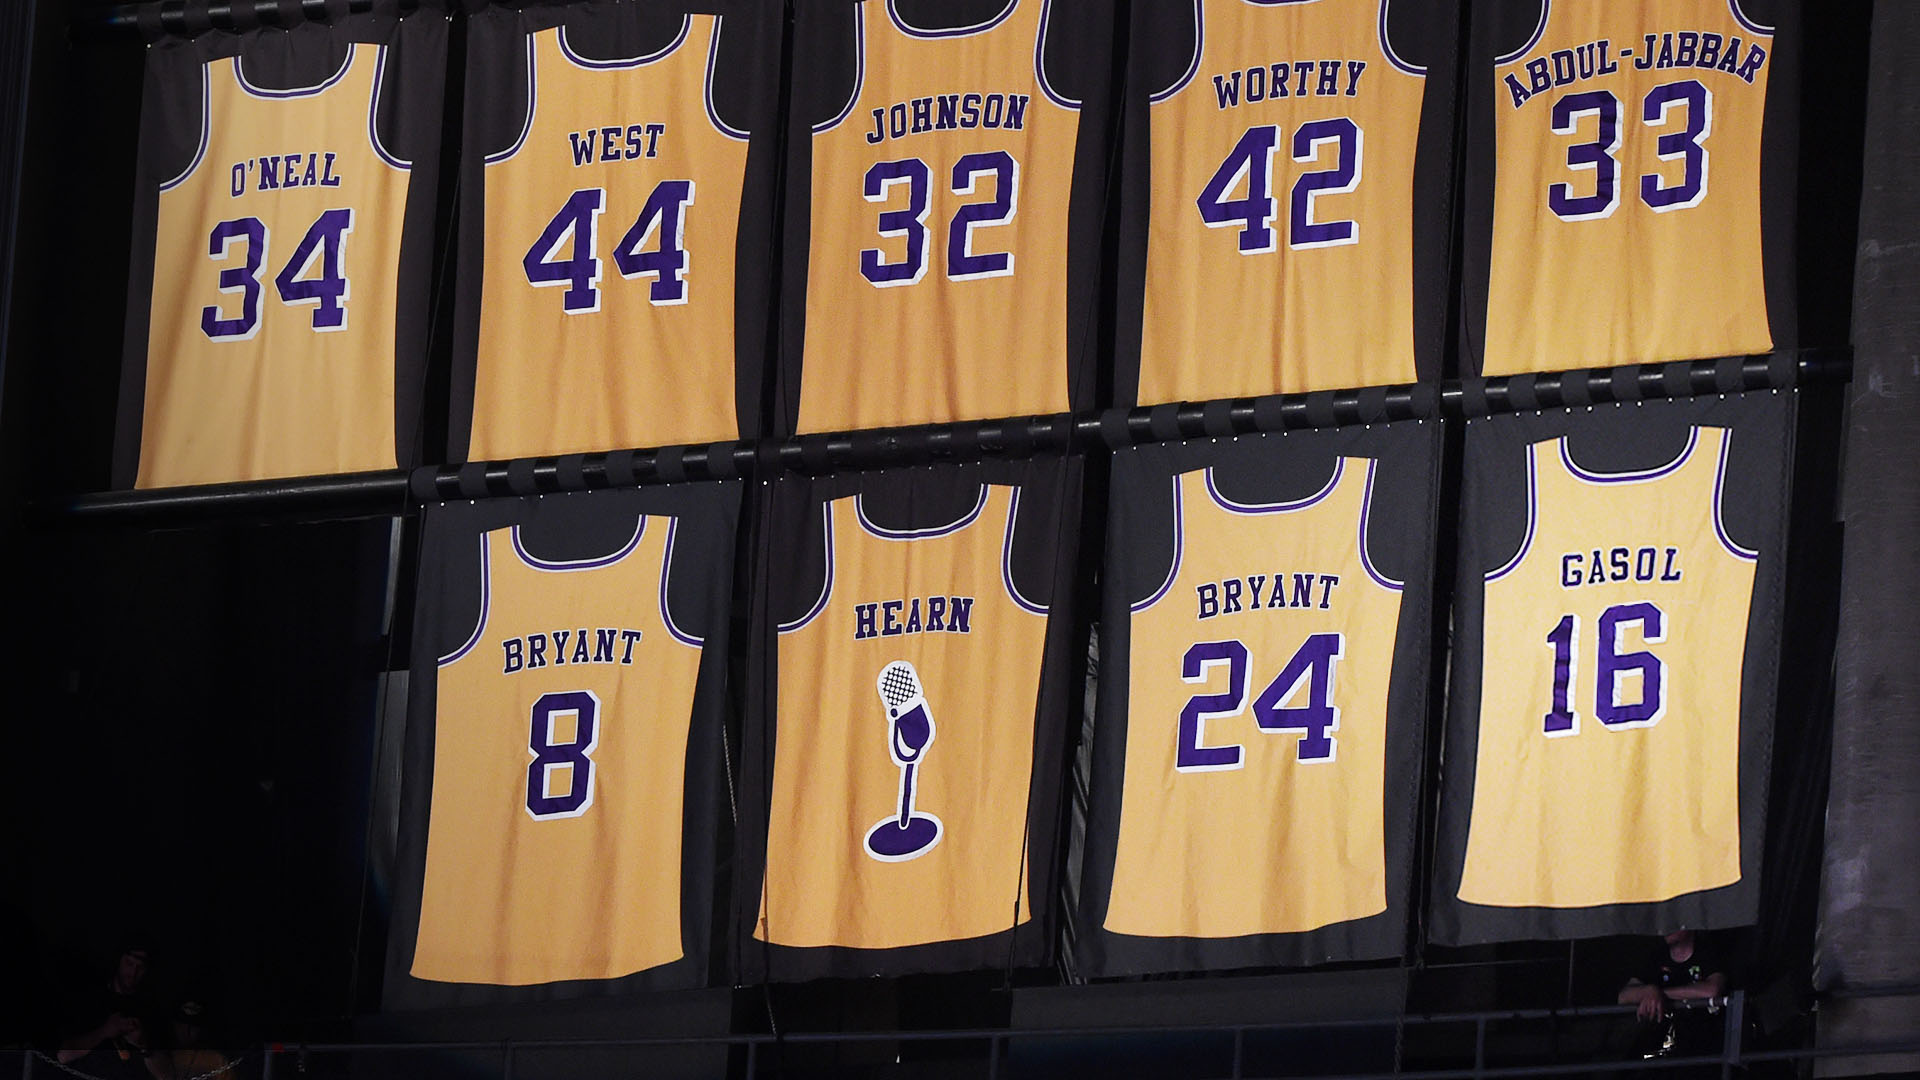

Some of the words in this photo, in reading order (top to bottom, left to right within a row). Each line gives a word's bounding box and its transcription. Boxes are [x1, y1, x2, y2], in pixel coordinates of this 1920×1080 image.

[1213, 60, 1366, 109] WORTHY
[1504, 30, 1767, 108] ABDUL-JABBAR
[569, 123, 665, 166] WEST
[866, 93, 1030, 144] JOHNSON
[1548, 80, 1714, 223] 33
[231, 152, 341, 197] O'NEAL
[1196, 117, 1363, 256] 42
[523, 180, 697, 316] 44
[860, 150, 1020, 288] 32
[201, 207, 355, 343] 34
[1196, 574, 1340, 619] BRYANT
[1560, 546, 1683, 589] GASOL
[503, 628, 642, 674] BRYANT
[854, 596, 974, 639] HEARN
[1176, 632, 1345, 773] 24
[1543, 601, 1668, 737] 16
[525, 689, 602, 821] 8
